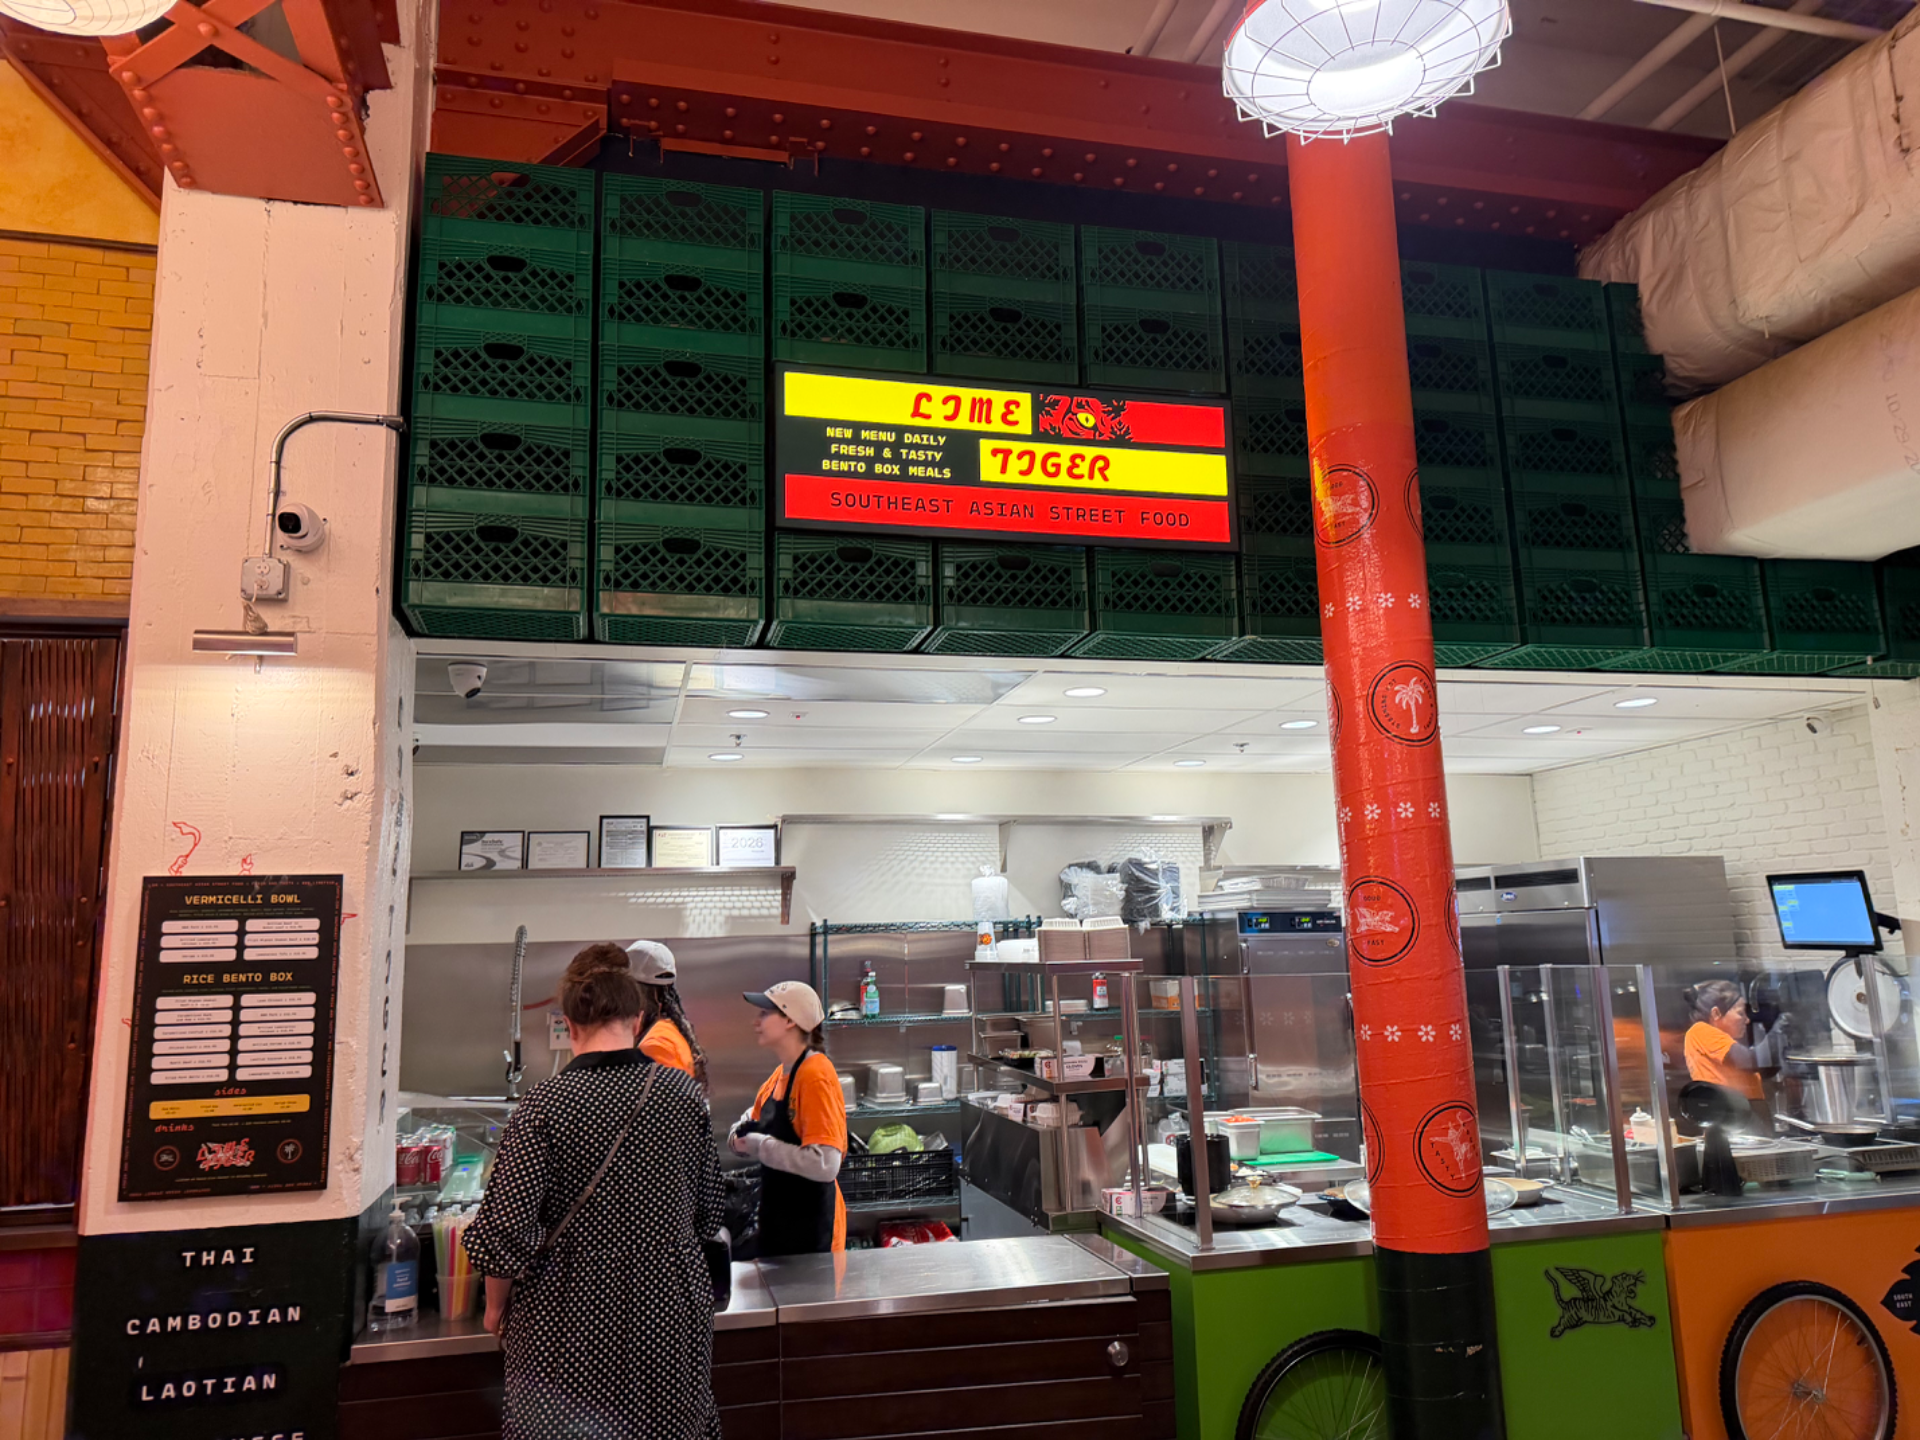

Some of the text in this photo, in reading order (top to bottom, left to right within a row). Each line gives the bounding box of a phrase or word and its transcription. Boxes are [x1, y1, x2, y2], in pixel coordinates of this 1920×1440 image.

[910, 391, 1021, 426] LIME
[826, 426, 947, 446] NEW MENU DAILY
[830, 443, 943, 462] FRESH & TASTY
[822, 459, 952, 479] BENTO BOX MEALS
[990, 447, 1111, 482] TIGER
[830, 491, 1190, 528] SOUTHEAST ASIAN STREET FOOD
[730, 836, 765, 849] 2026
[184, 893, 301, 905] VERMICELLI BOWL
[183, 971, 294, 985] RICE BENTO BOX
[214, 1086, 247, 1096] sides
[154, 1123, 195, 1133] drinks
[1430, 1142, 1456, 1181] TASTY
[181, 1247, 256, 1267] THAI
[126, 1306, 302, 1336] CAMBODIAN
[140, 1373, 278, 1402] LAOTIAN
